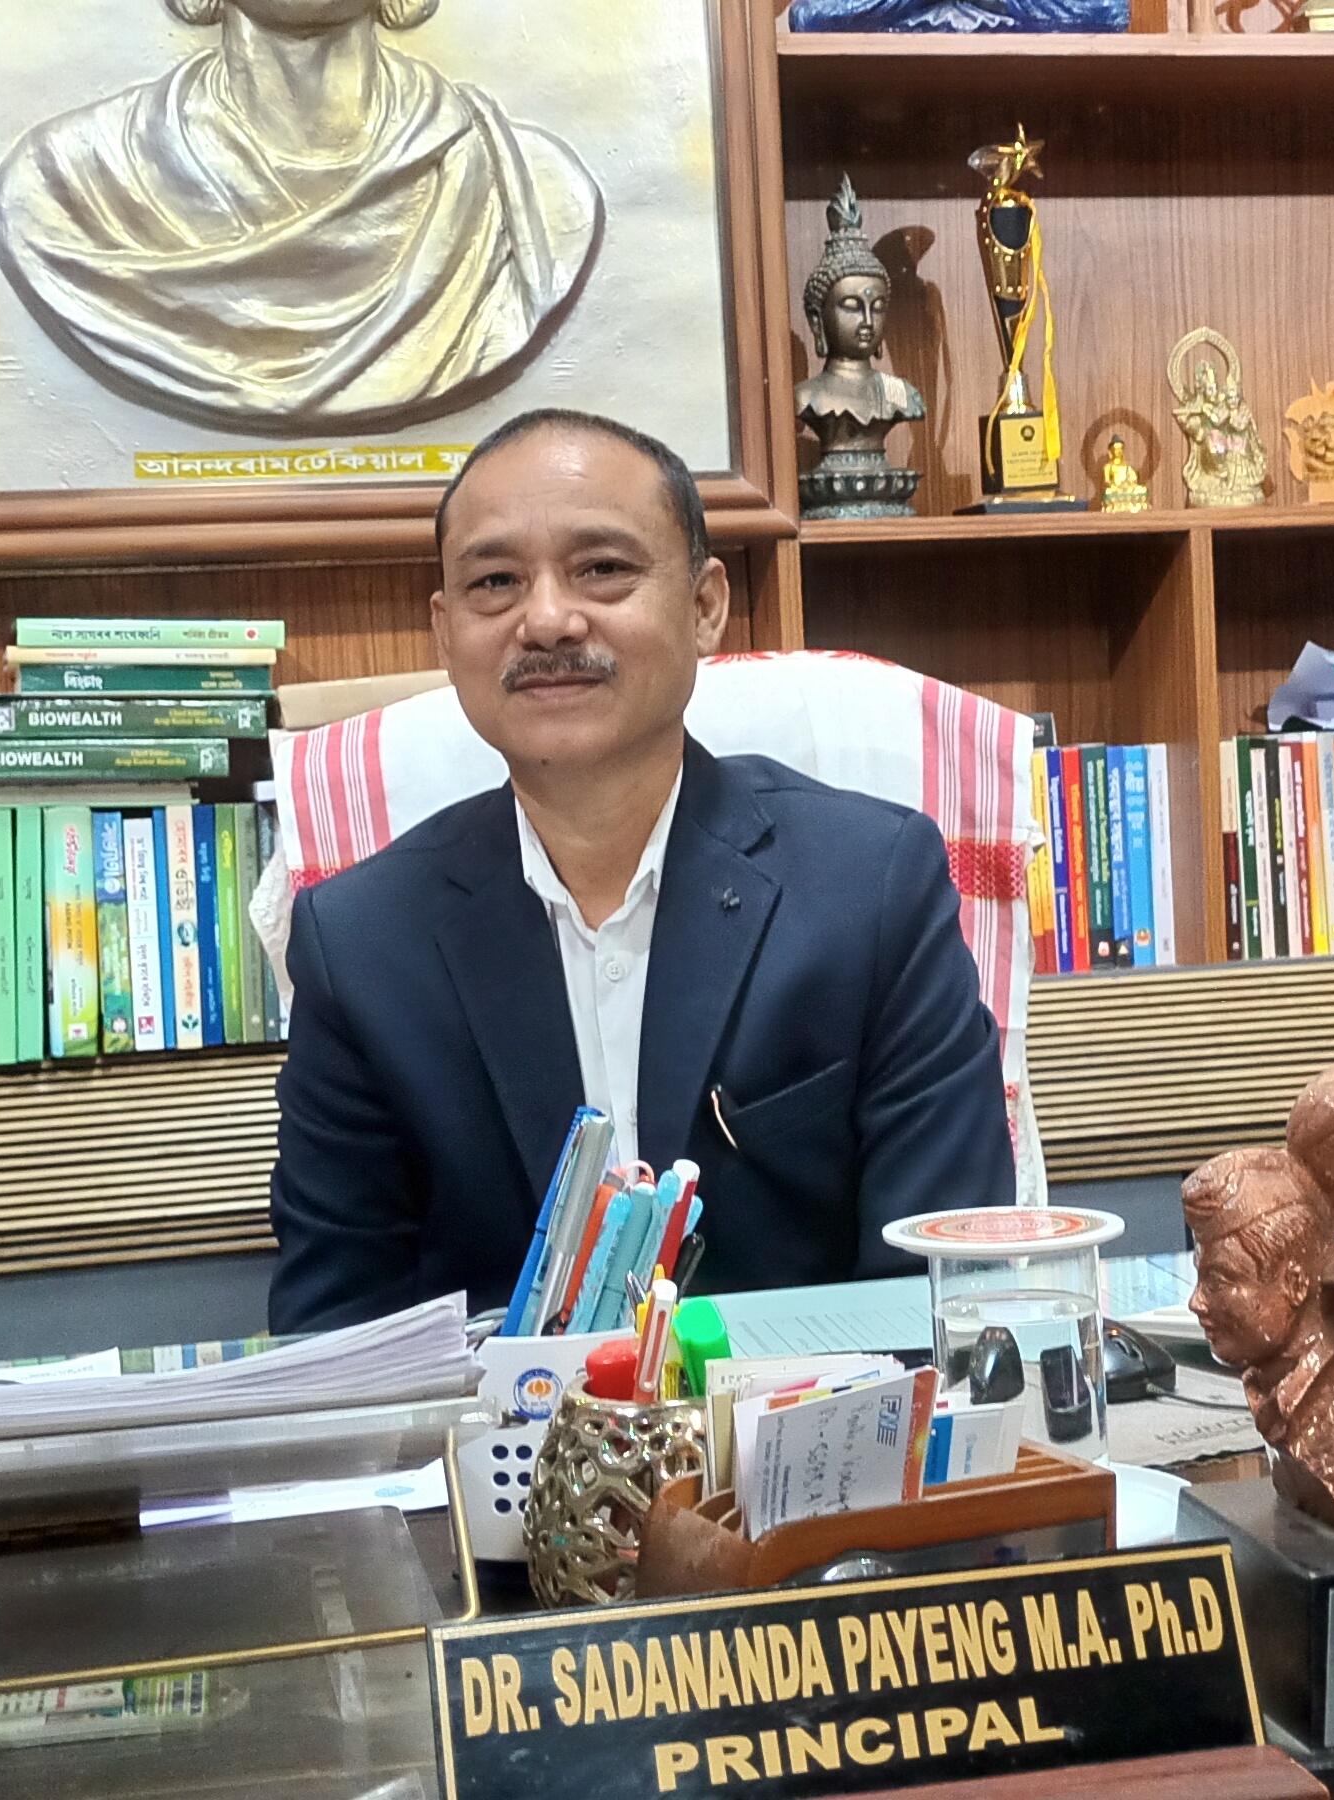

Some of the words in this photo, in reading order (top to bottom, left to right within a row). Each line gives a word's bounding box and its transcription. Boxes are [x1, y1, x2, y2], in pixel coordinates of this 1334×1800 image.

[28, 711, 123, 727] BIOWEALTH
[460, 1654, 540, 1738] DR.
[553, 1618, 834, 1728] SADANANDA
[842, 1602, 1017, 1694] PAYENG
[1023, 1591, 1123, 1672] M.A.
[1129, 1576, 1225, 1660] Ph.D
[655, 1697, 1065, 1792] PRINCIPAL
